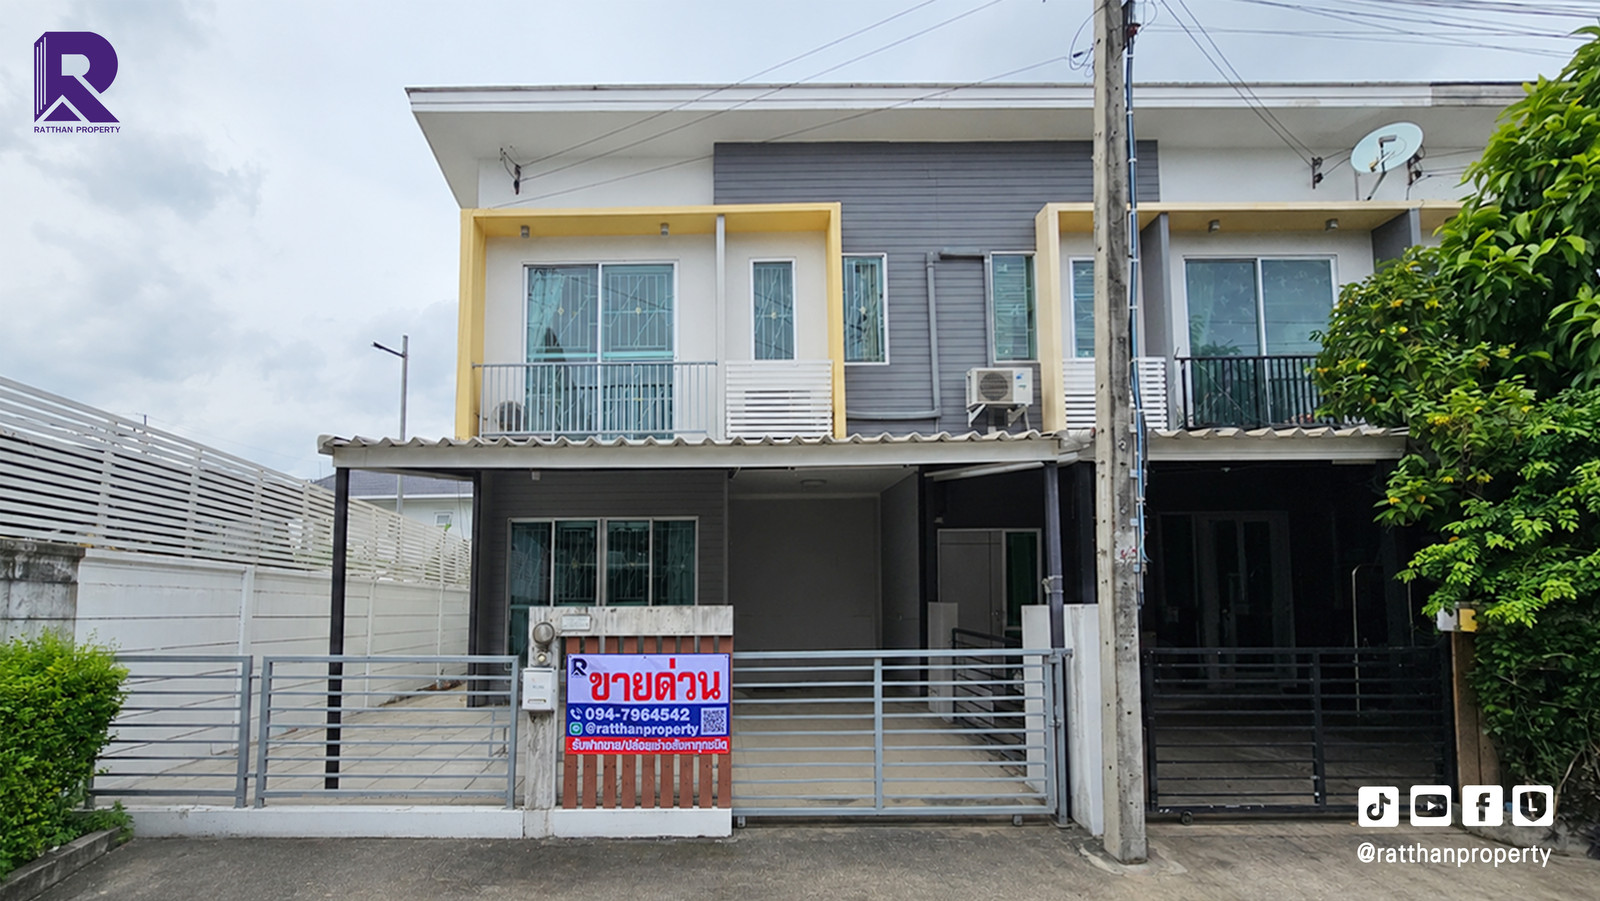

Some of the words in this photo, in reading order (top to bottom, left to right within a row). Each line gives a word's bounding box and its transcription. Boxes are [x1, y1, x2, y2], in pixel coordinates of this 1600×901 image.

[590, 658, 721, 701] ขายด่วน
[585, 707, 691, 722] 094-7964542
[585, 722, 699, 737] @ratthanproperty
